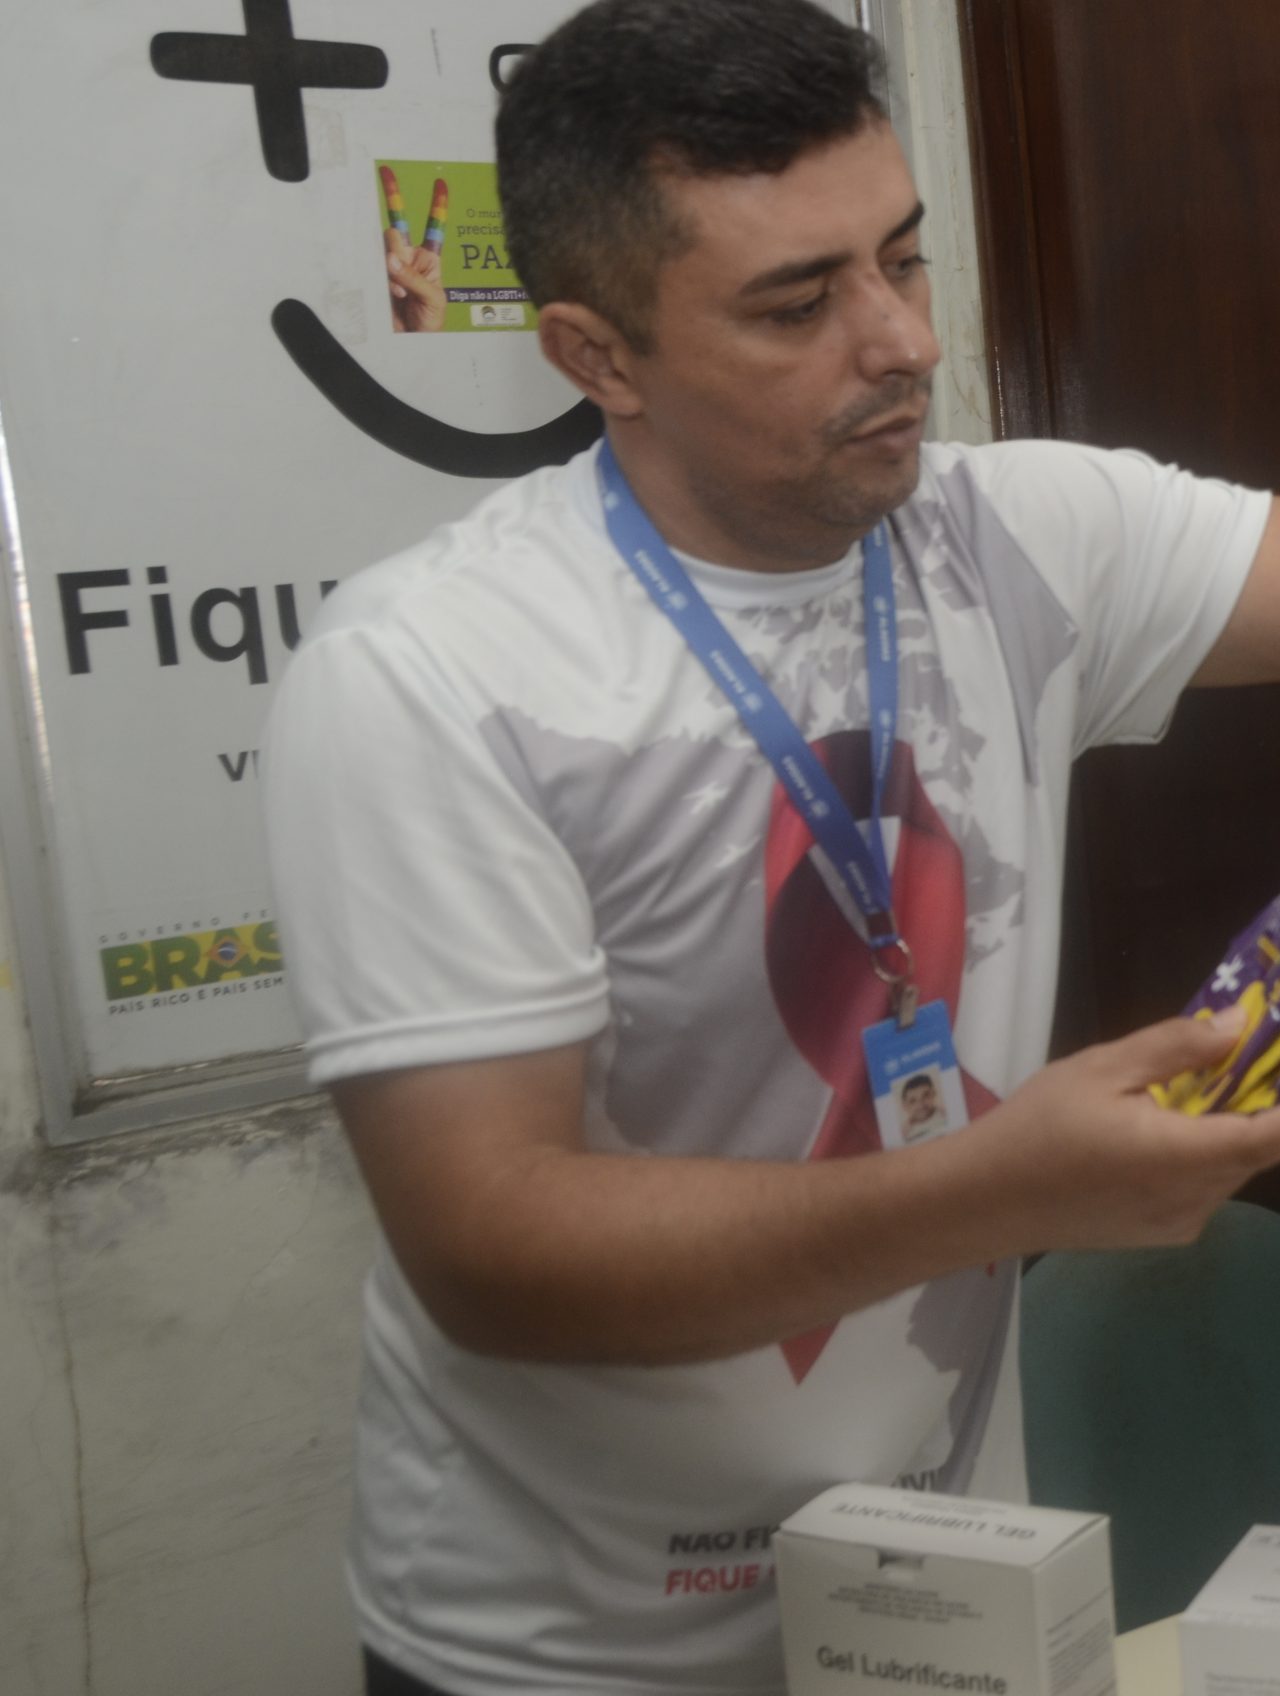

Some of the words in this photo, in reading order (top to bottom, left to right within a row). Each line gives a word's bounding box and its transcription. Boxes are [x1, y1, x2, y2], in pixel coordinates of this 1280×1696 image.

[460, 244, 514, 269] PA
[153, 992, 190, 1008] RICO
[198, 989, 207, 1000] E
[254, 976, 284, 989] SEM
[664, 1563, 759, 1597] FIQUE
[816, 1645, 855, 1673] Gel
[860, 1652, 1009, 1695] Lubrificante
